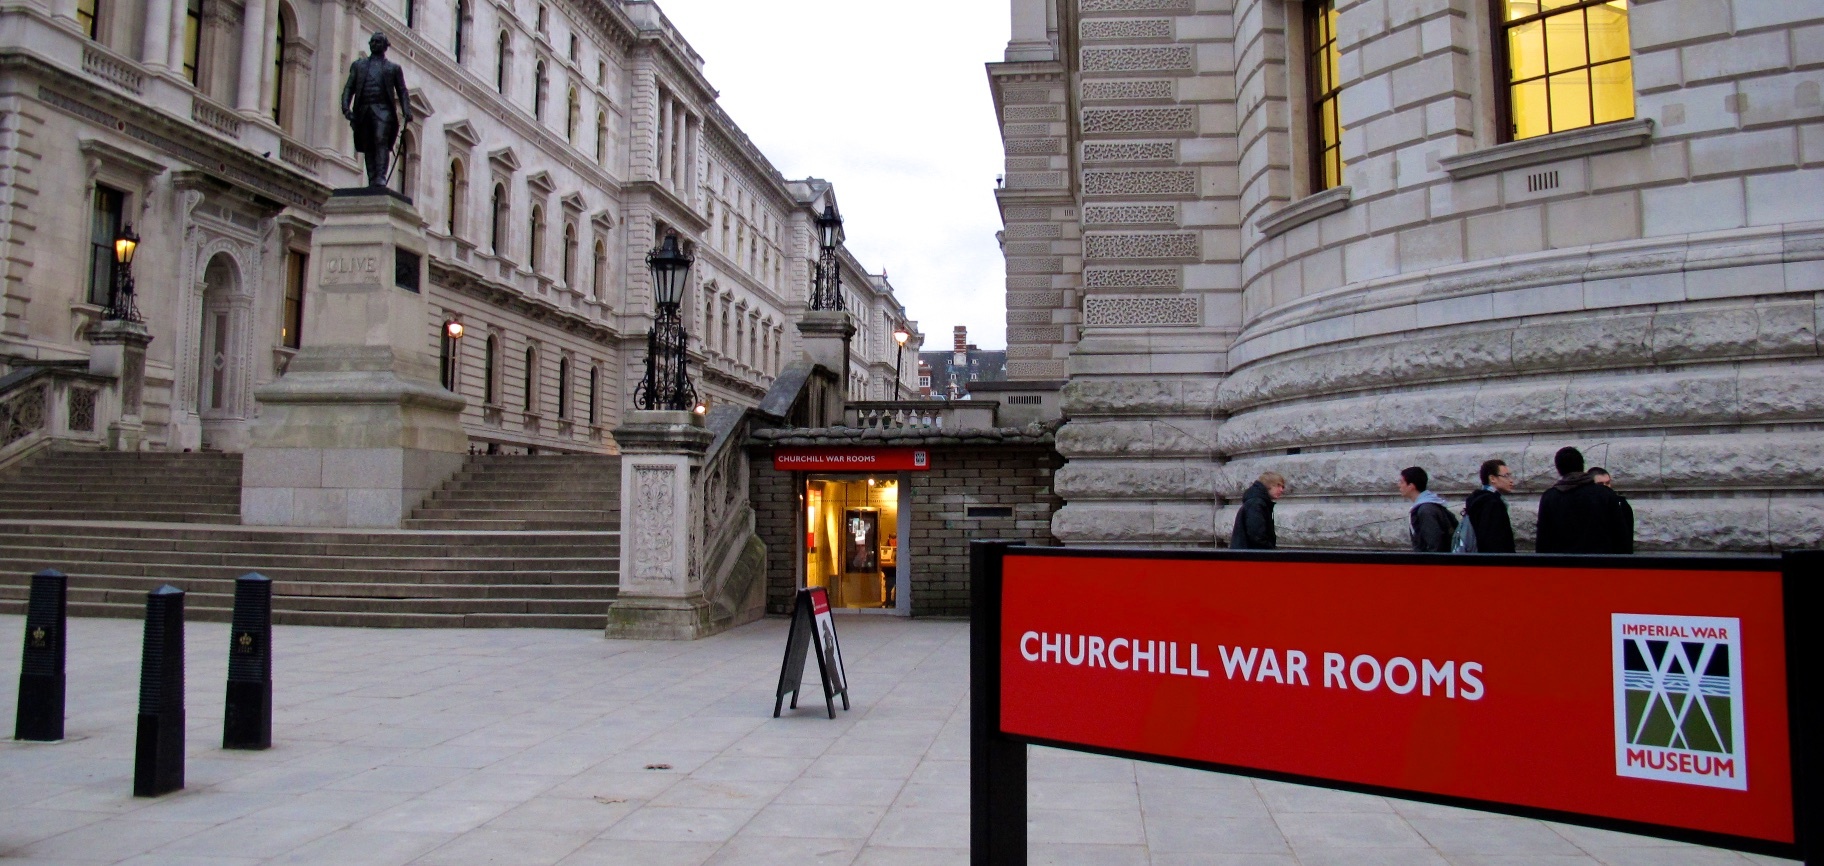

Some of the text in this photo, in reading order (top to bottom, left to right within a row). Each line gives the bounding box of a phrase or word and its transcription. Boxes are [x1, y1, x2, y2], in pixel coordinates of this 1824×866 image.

[327, 257, 377, 273] CLIVE
[778, 455, 876, 463] CHURCHILL WAR ROOMS
[1622, 623, 1728, 640] IMPERIAL WAR
[1019, 630, 1485, 701] CHURCHILL WAR ROOMS
[1626, 747, 1735, 779] MUSEUM
